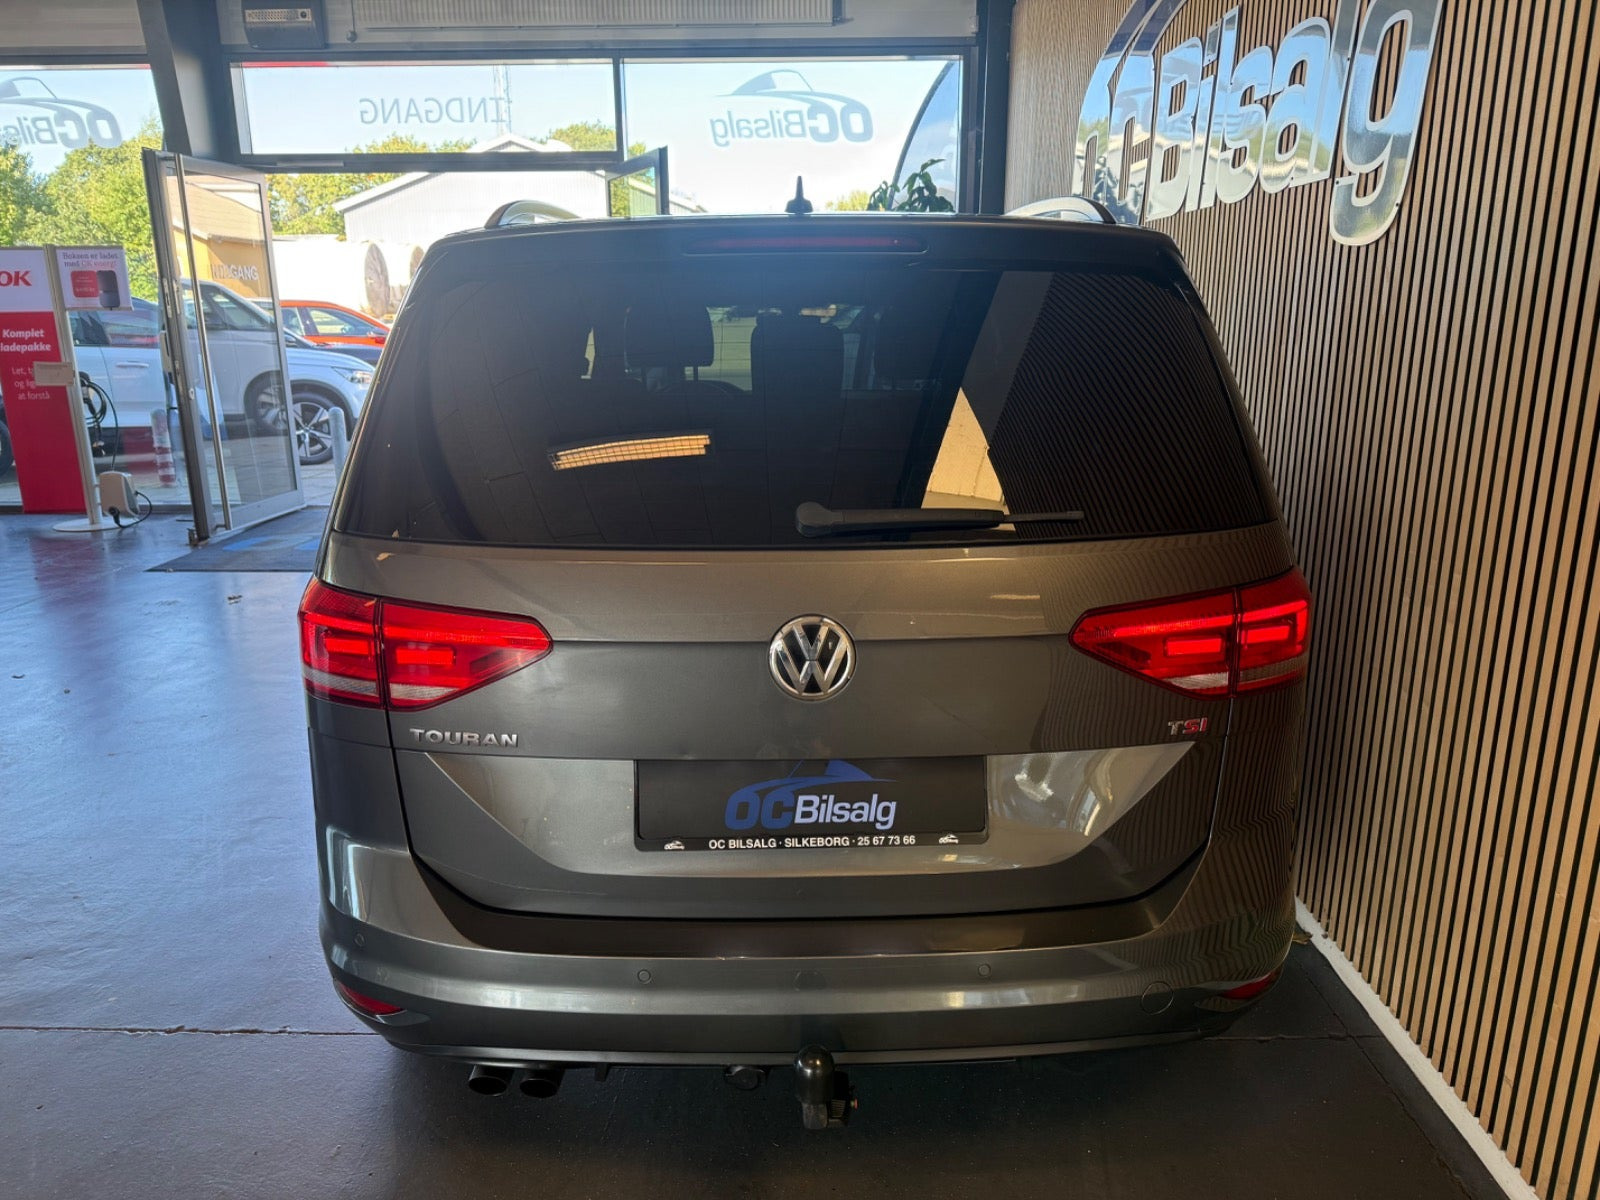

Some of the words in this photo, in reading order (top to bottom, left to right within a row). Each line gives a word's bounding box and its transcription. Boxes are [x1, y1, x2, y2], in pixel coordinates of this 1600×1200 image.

[0, 270, 32, 287] OK
[2, 328, 45, 340] Komplet
[0, 342, 51, 354] ladepakke
[1167, 717, 1208, 736] TSI
[409, 728, 518, 747] TOURAN
[708, 839, 726, 849] OC
[728, 838, 777, 849] BILSALG
[784, 836, 850, 848] SILKEBORG
[857, 836, 871, 846] 25
[872, 836, 885, 846] 67
[888, 835, 901, 846] 73
[902, 835, 916, 845] 66
